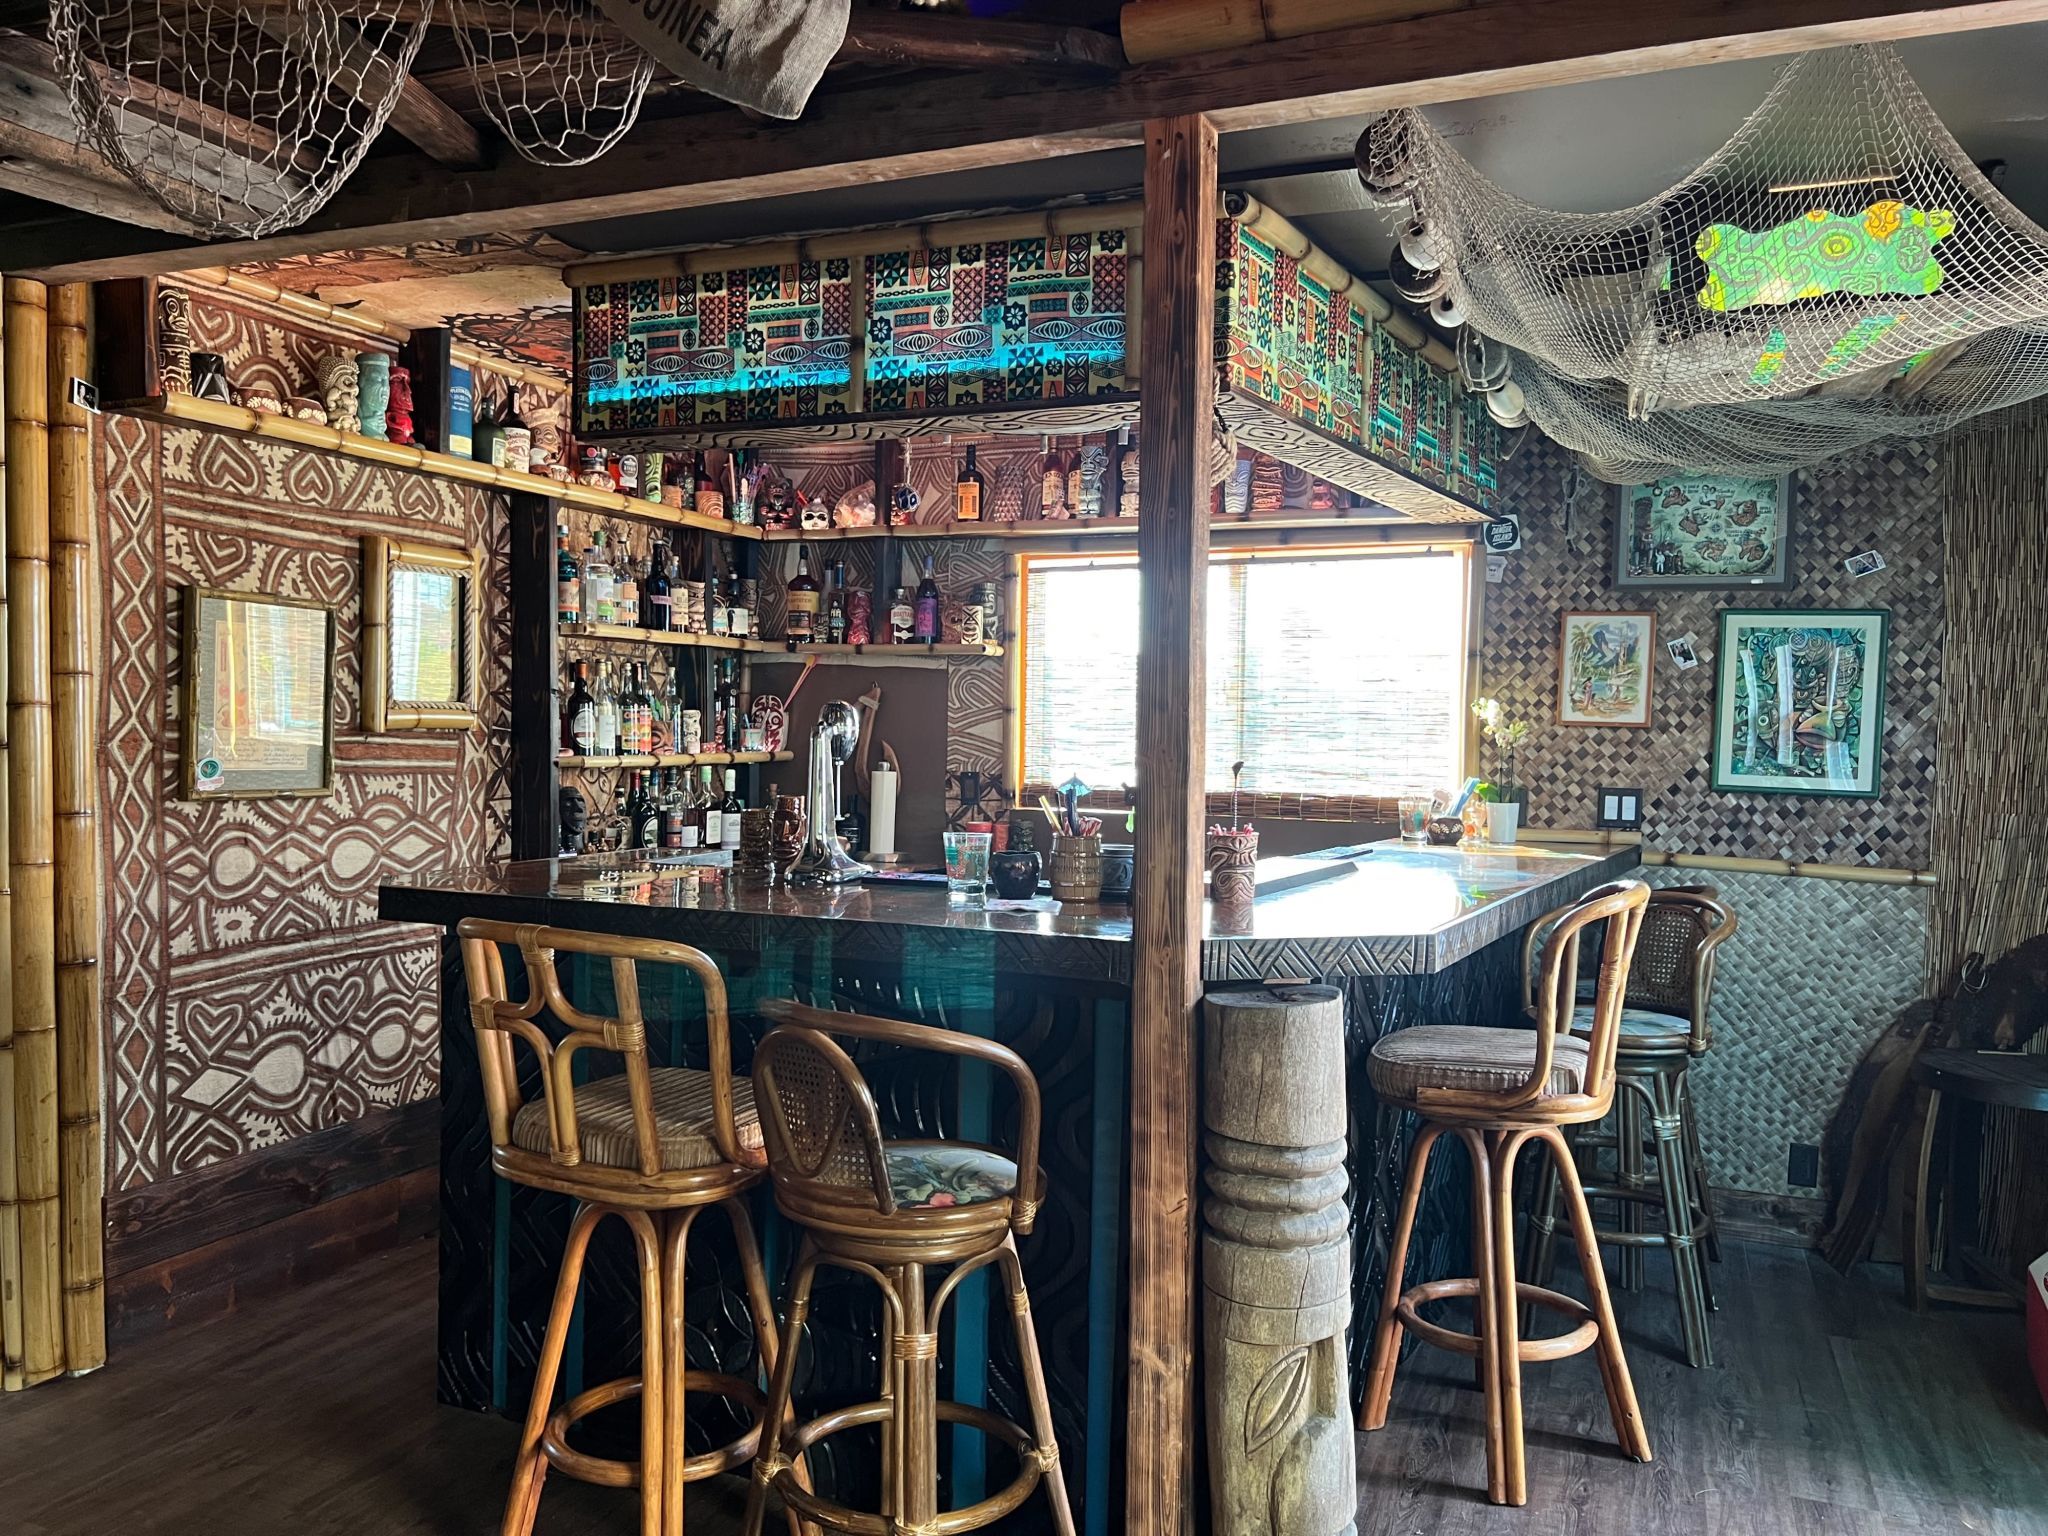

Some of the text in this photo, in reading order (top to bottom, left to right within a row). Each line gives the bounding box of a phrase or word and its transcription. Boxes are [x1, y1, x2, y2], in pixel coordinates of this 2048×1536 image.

[627, 0, 733, 71] UINEA
[1491, 525, 1512, 535] DANGER
[1492, 533, 1513, 542] ISLAND
